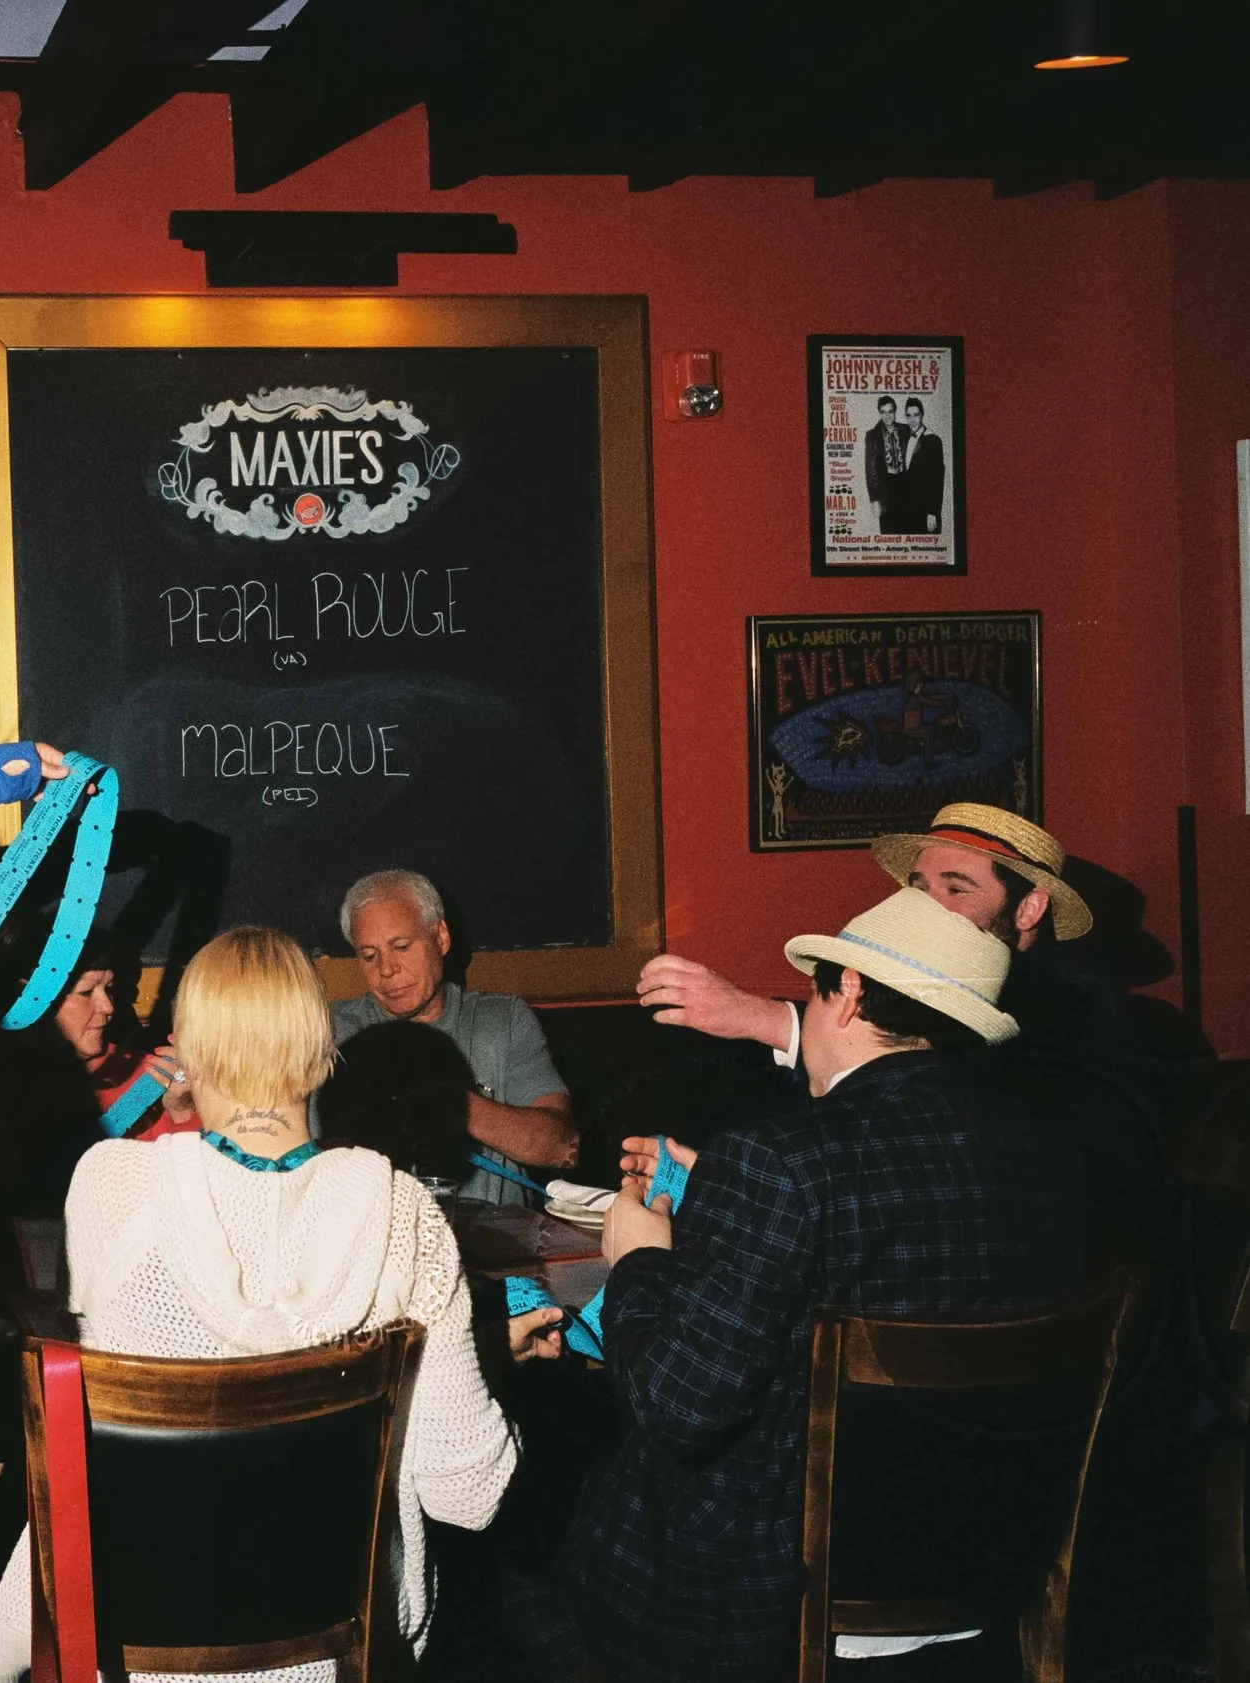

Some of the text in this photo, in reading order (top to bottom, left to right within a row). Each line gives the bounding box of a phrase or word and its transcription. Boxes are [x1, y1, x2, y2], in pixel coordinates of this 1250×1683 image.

[826, 359, 940, 375] JOHNNY CASH &
[827, 374, 939, 390] ELVIS PRESLEY
[830, 411, 850, 426] CARL
[823, 427, 857, 442] PERKINS
[229, 429, 384, 487] MAXIE'S
[832, 535, 940, 545] National Guard Armory
[312, 567, 469, 640] ROUGE
[765, 630, 799, 649] ALL
[273, 651, 307, 671] (VA)
[775, 648, 855, 716] EVEL
[64, 781, 82, 808] TICKET
[262, 786, 319, 808] (PEI)
[44, 815, 63, 843] TICKET
[24, 847, 44, 875] TICKET
[4, 879, 24, 908] TICKET
